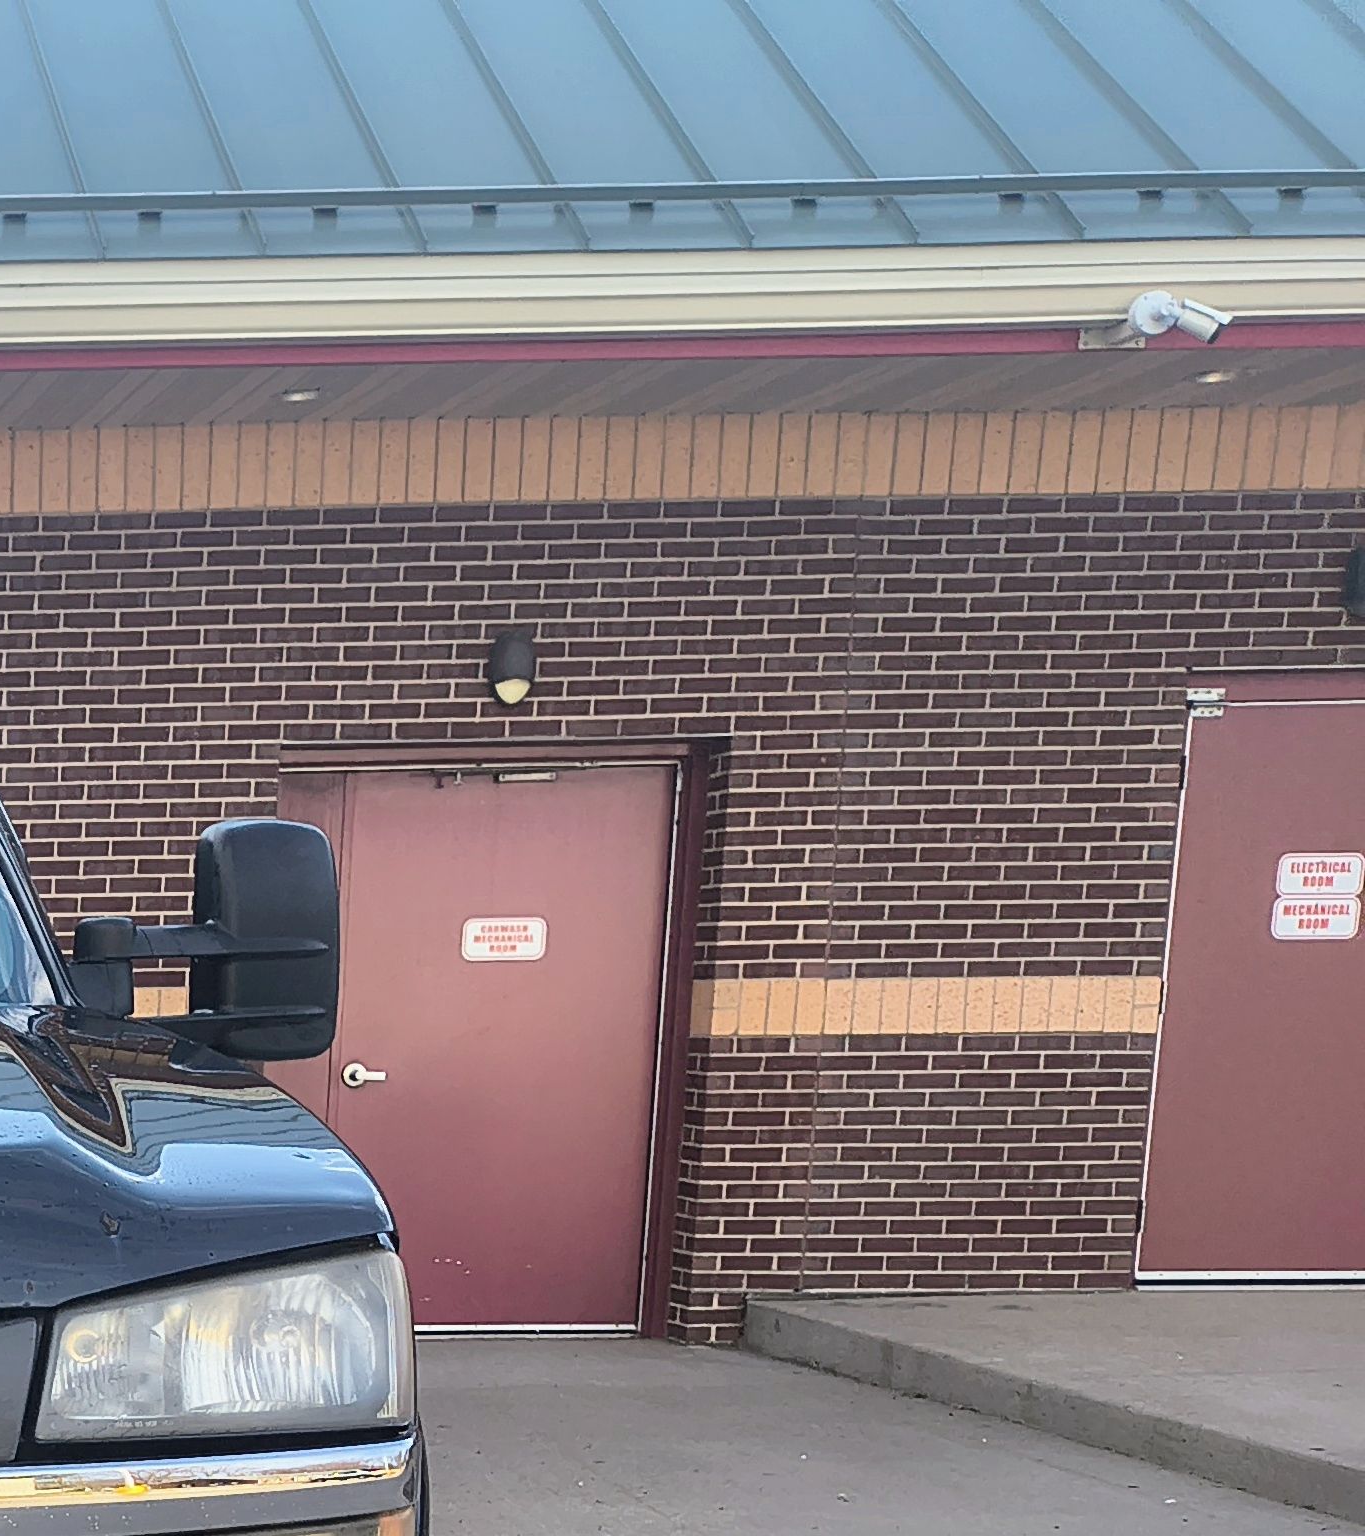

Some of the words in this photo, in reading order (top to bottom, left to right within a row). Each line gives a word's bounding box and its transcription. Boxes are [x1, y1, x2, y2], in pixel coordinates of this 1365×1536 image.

[1290, 861, 1352, 873] ELECTRICAL
[1302, 876, 1334, 887] ROOM
[1283, 904, 1350, 916] MECHANICAL
[480, 925, 528, 933] CARWASH
[1298, 918, 1330, 929] ROOM
[473, 935, 533, 943] MECHANICAL
